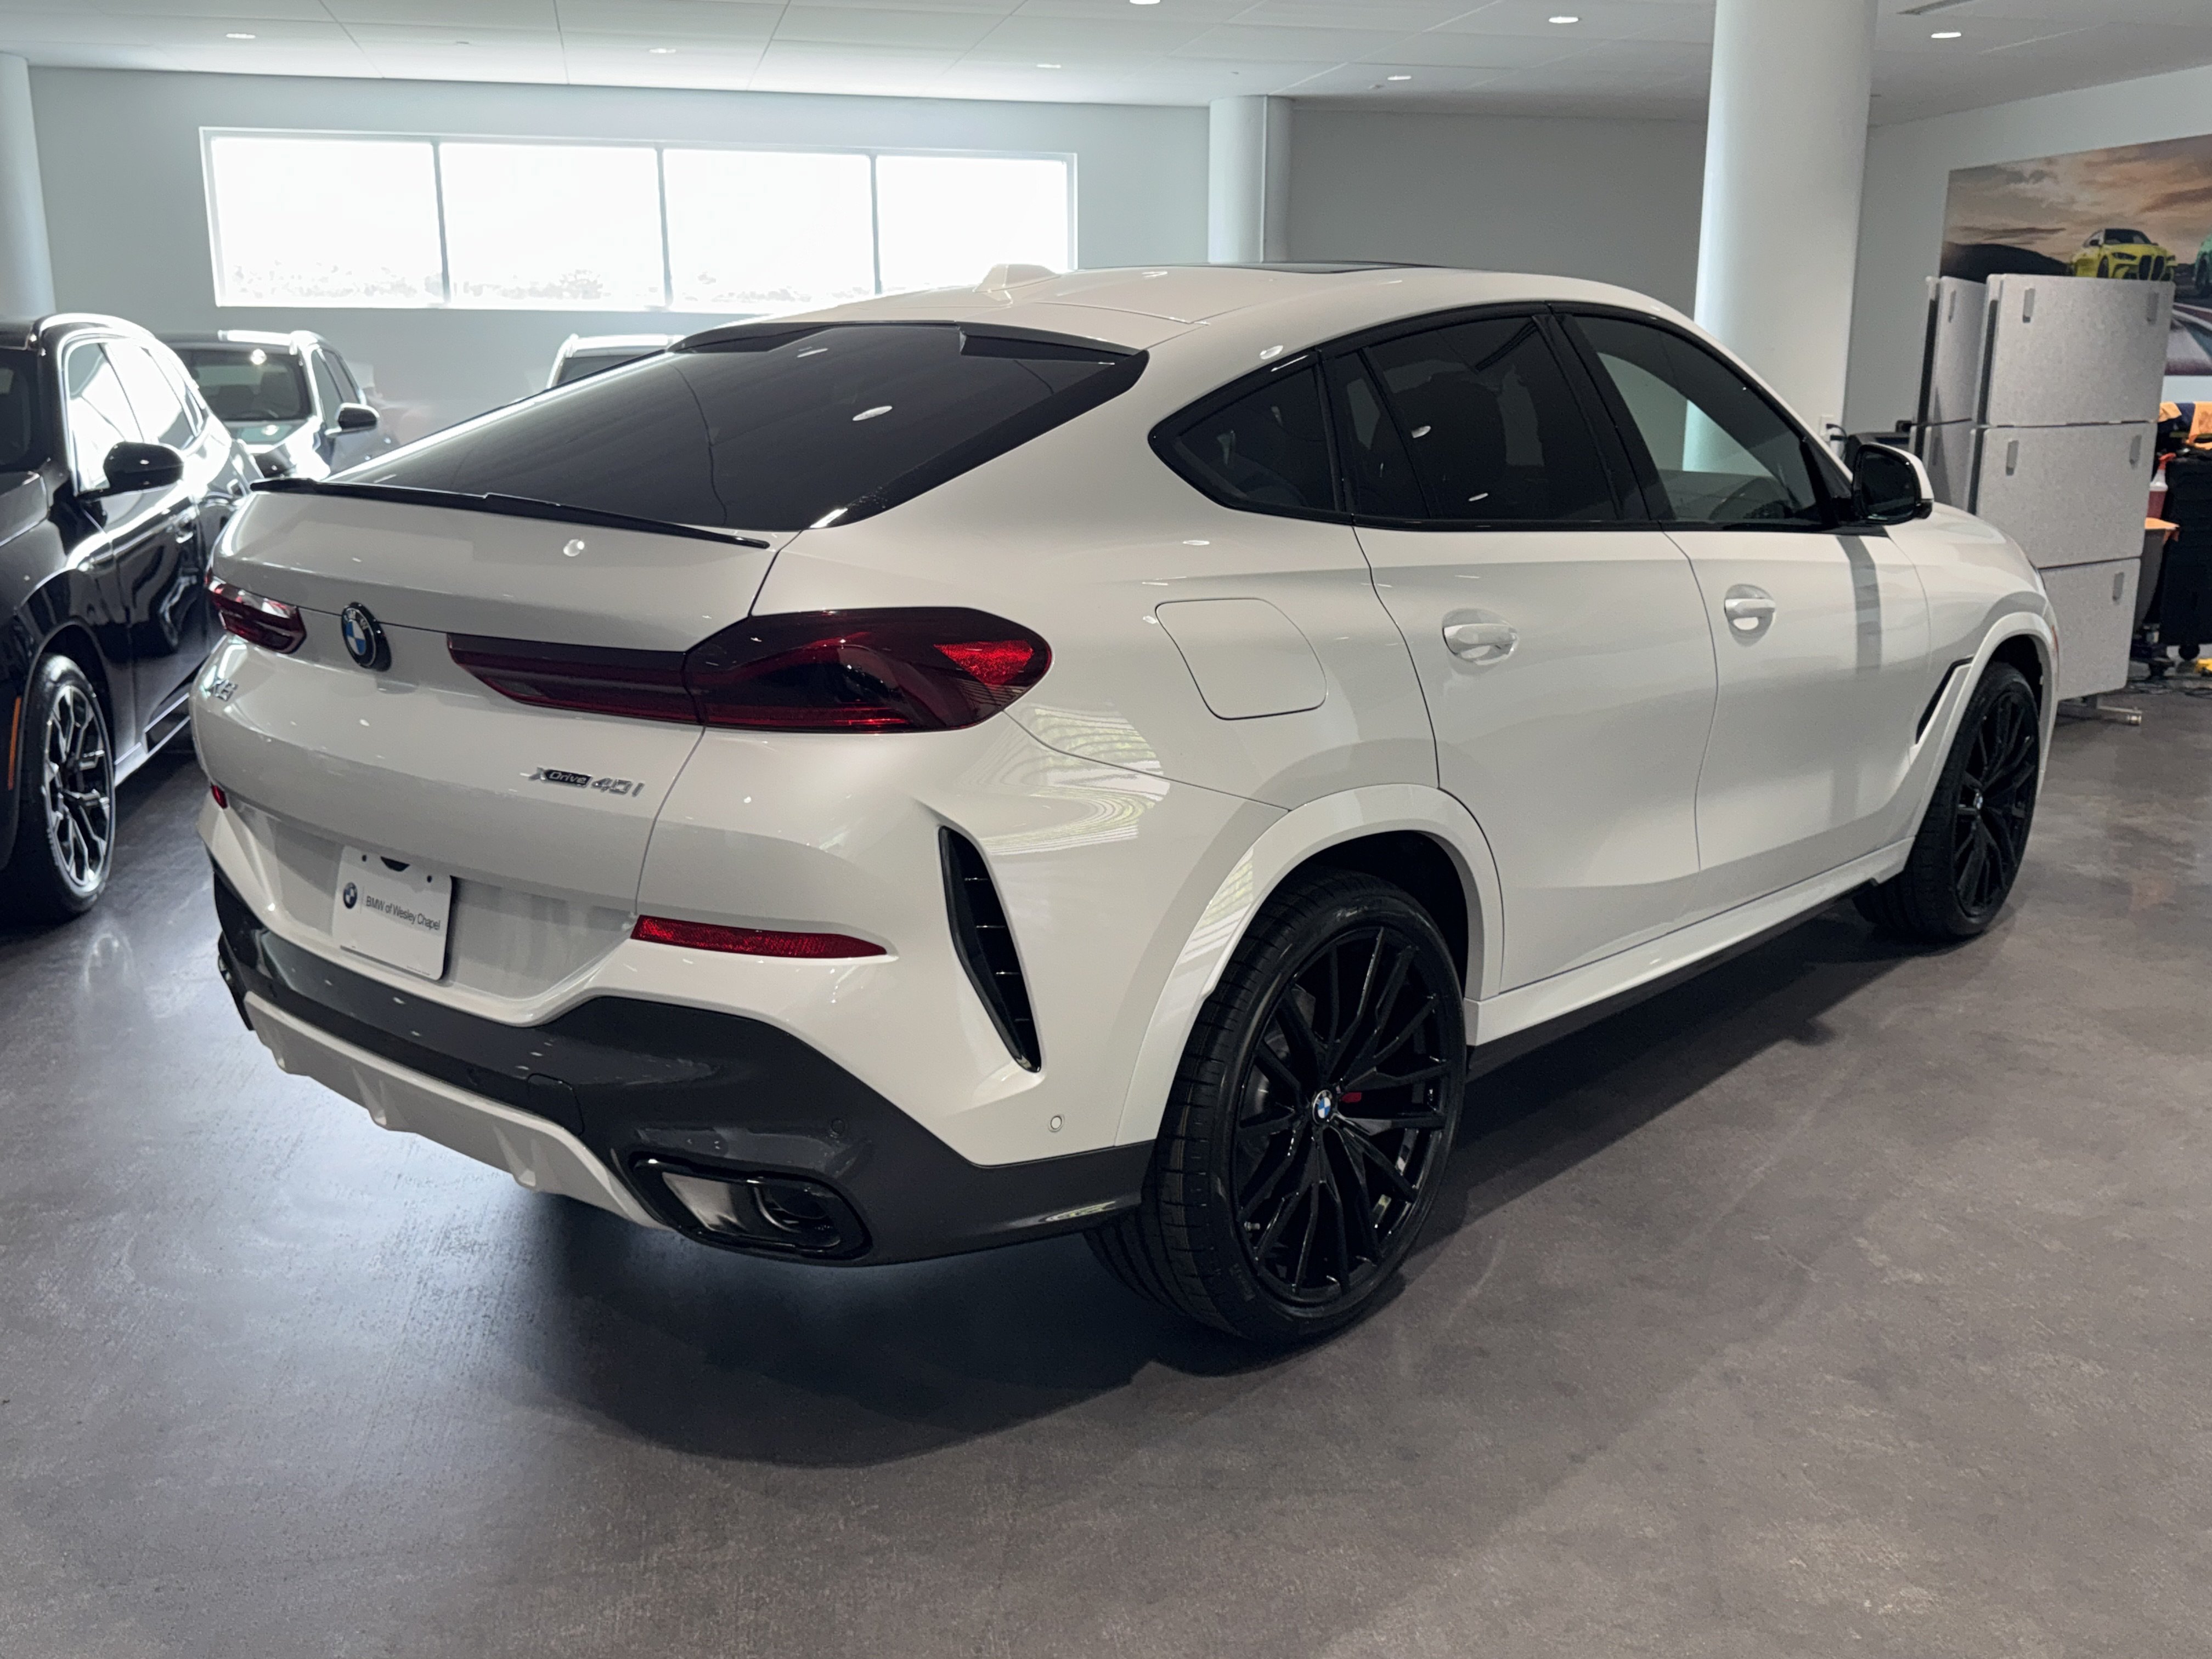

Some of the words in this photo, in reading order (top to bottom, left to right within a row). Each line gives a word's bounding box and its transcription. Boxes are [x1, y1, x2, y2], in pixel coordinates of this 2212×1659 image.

[366, 895, 385, 911] BMW
[385, 903, 393, 914] of
[393, 904, 417, 925] Wesley
[417, 913, 441, 930] Chapel
